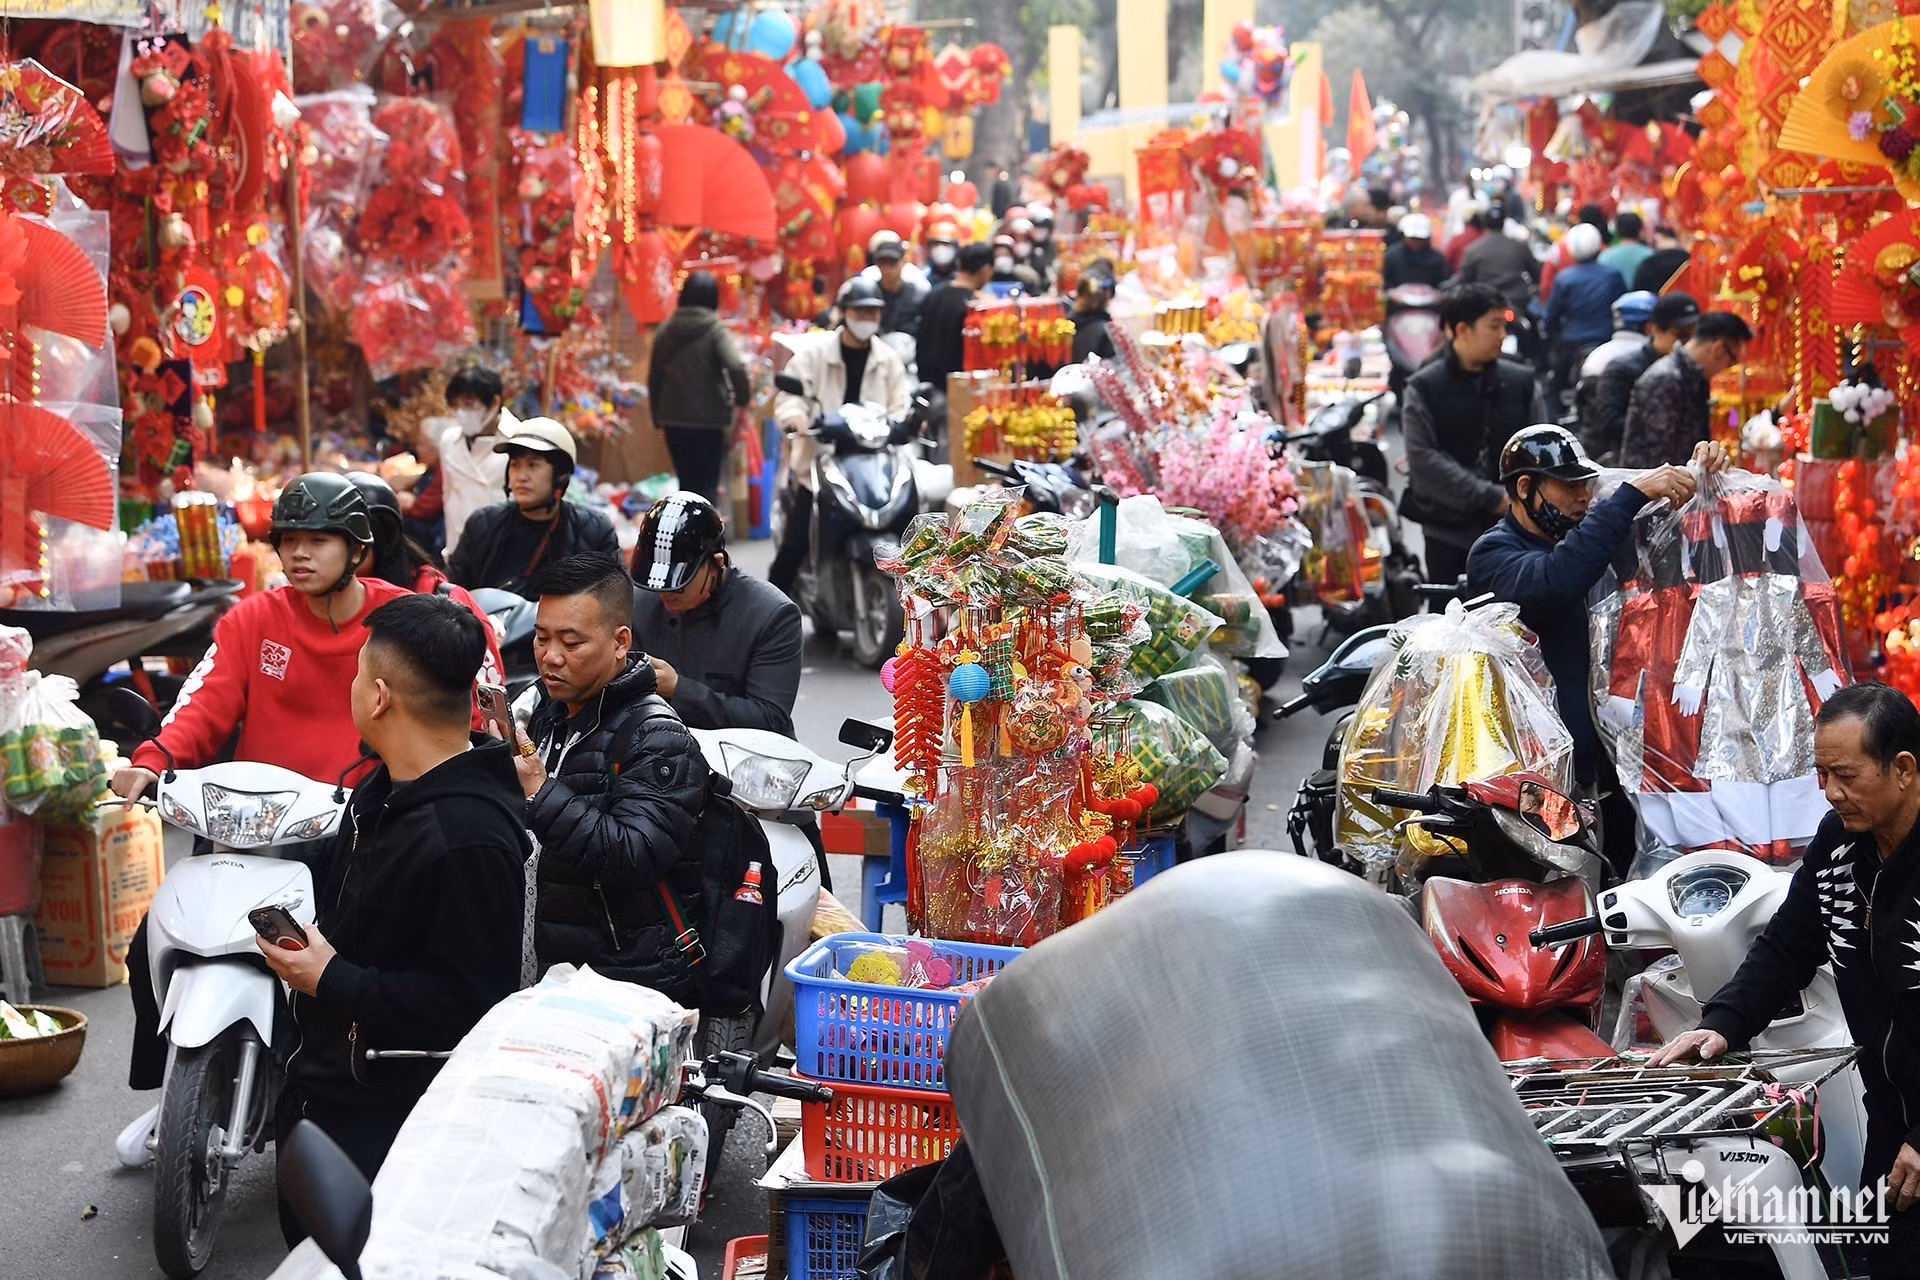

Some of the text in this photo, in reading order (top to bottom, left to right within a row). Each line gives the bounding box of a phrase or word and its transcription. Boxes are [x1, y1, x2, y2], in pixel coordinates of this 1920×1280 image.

[210, 860, 245, 869] HONDA
[1494, 887, 1533, 897] HONDA
[1719, 1151, 1770, 1165] VISION
